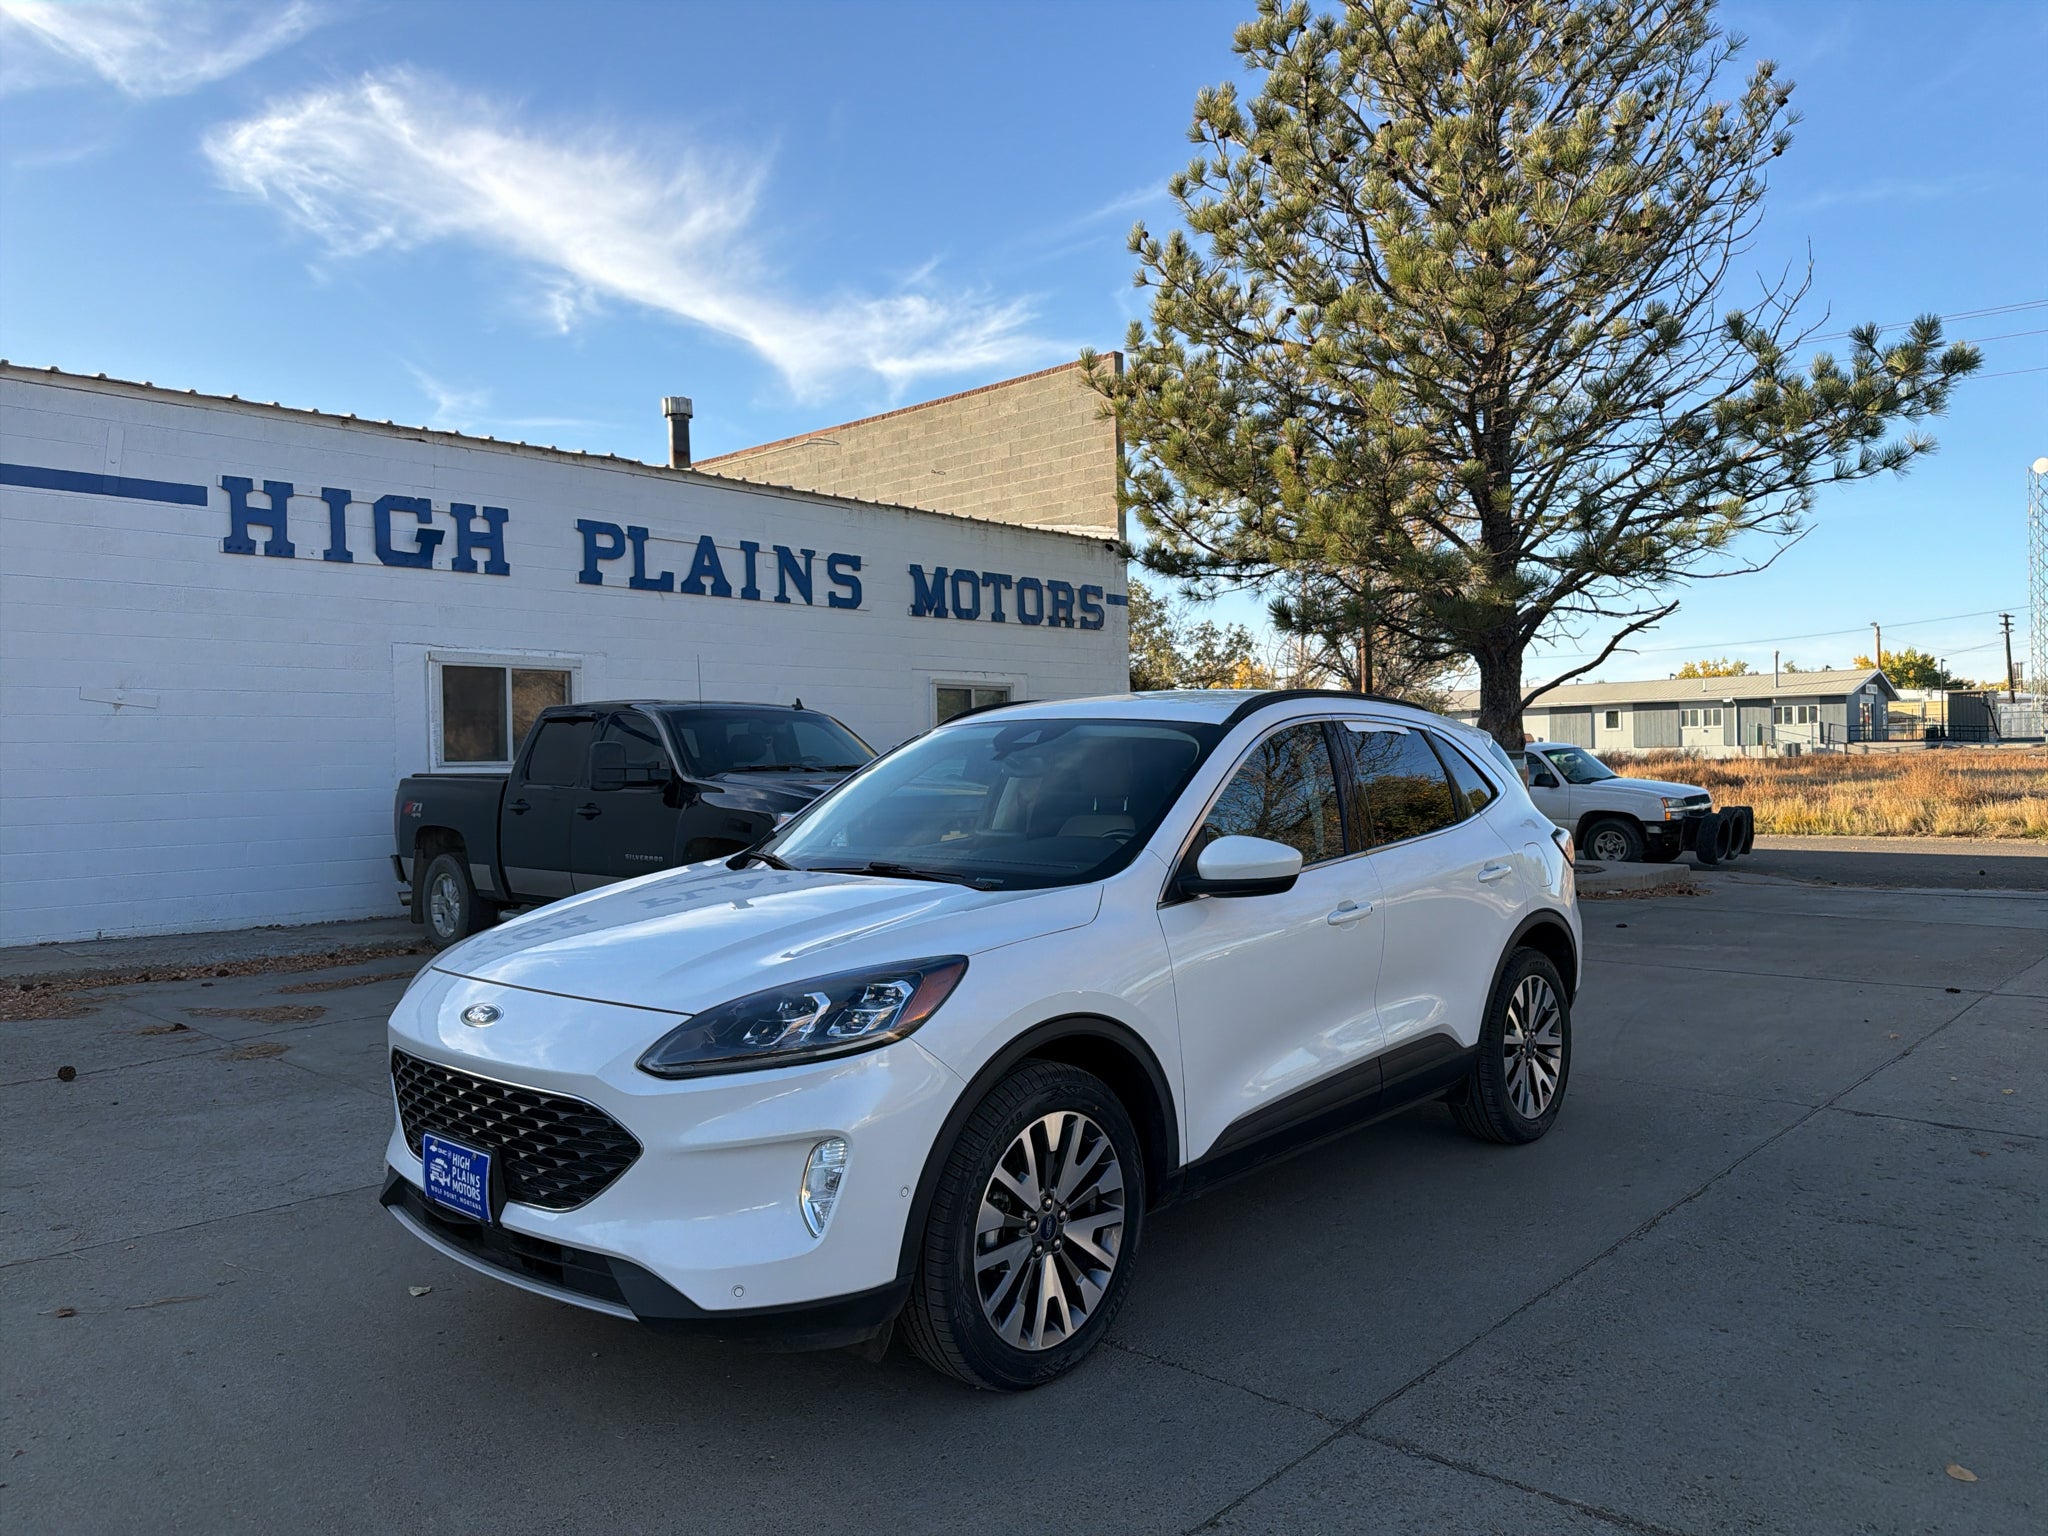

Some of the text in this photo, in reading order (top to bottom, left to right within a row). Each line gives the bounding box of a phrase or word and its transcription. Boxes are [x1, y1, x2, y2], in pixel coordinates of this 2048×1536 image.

[221, 475, 1105, 631] HIGH PLAINS MOTORS
[452, 1153, 471, 1170] HIGH
[452, 1166, 480, 1187] PLAINS
[452, 1180, 481, 1201] MOTORS
[460, 1197, 482, 1211] MONTANA
